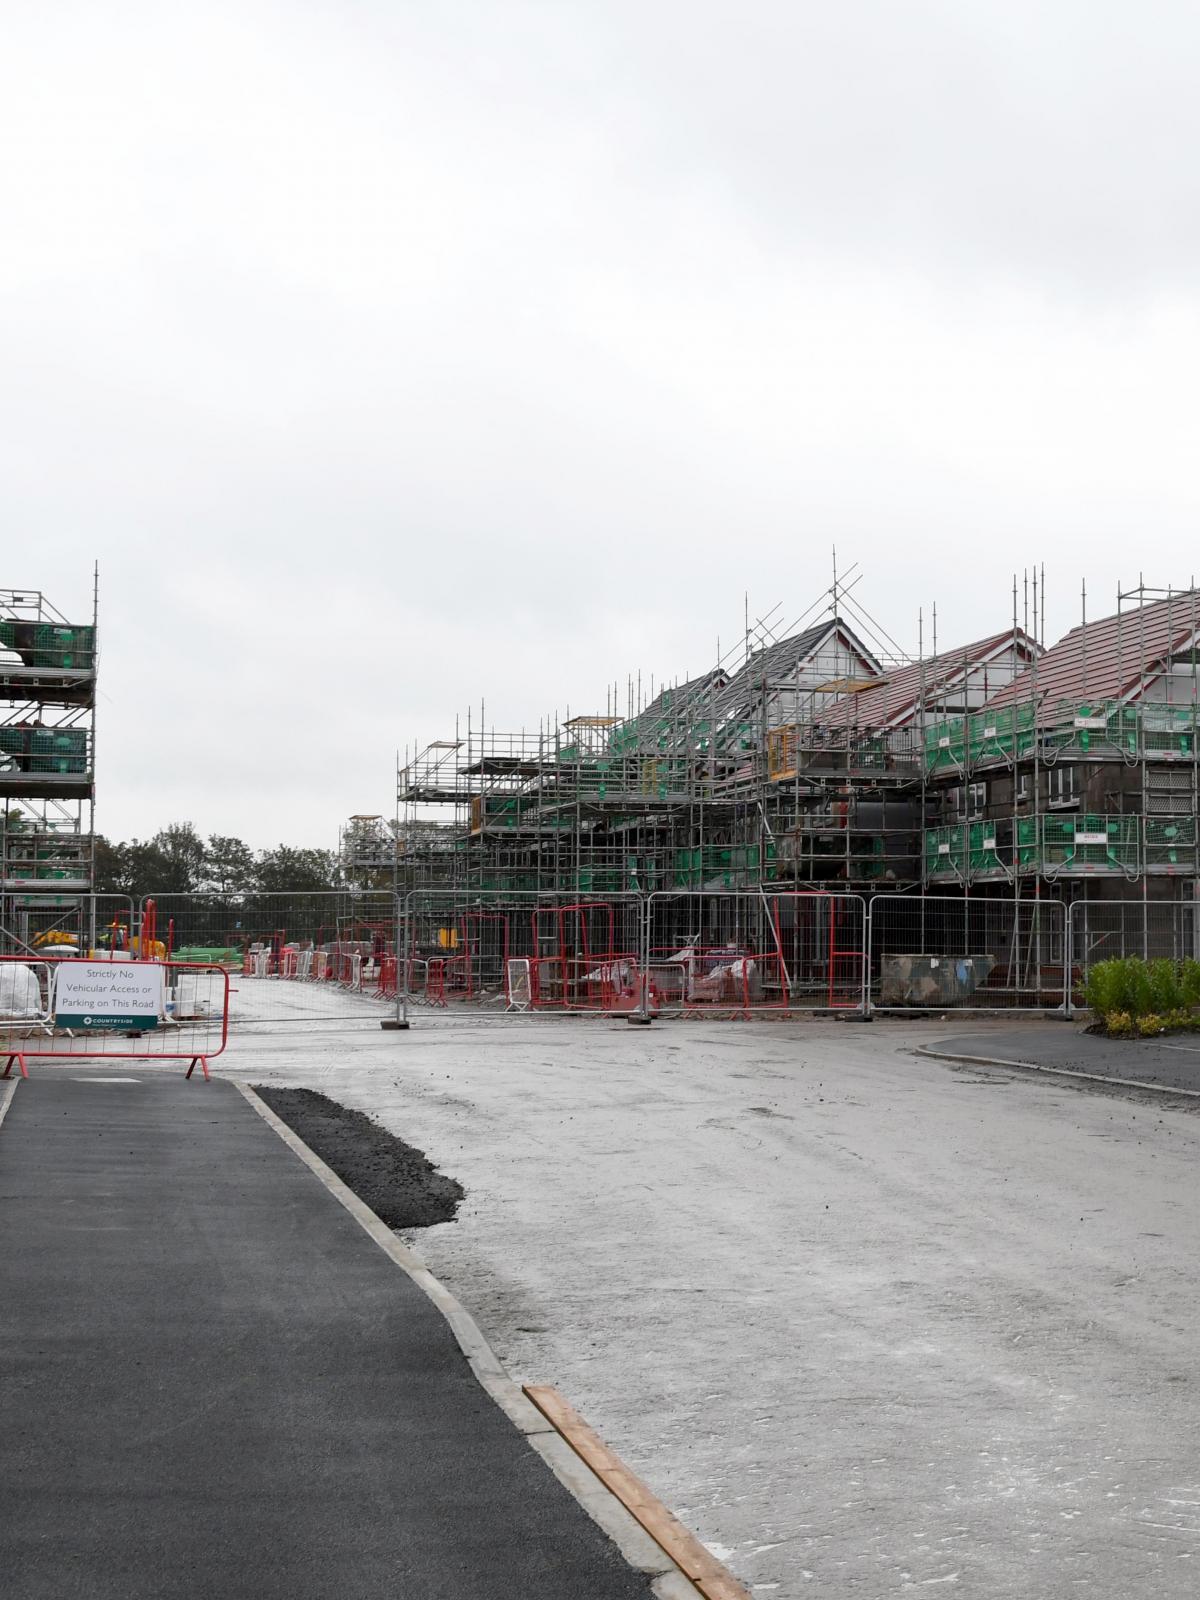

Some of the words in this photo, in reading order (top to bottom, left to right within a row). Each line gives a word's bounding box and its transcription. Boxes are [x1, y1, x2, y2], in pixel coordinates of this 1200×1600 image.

[87, 969, 116, 979] Strictly
[120, 970, 134, 979] No
[66, 983, 107, 992] Vehicular
[110, 985, 139, 993] Access
[62, 998, 95, 1009] Parking
[112, 999, 130, 1008] This
[132, 1000, 154, 1008] Road
